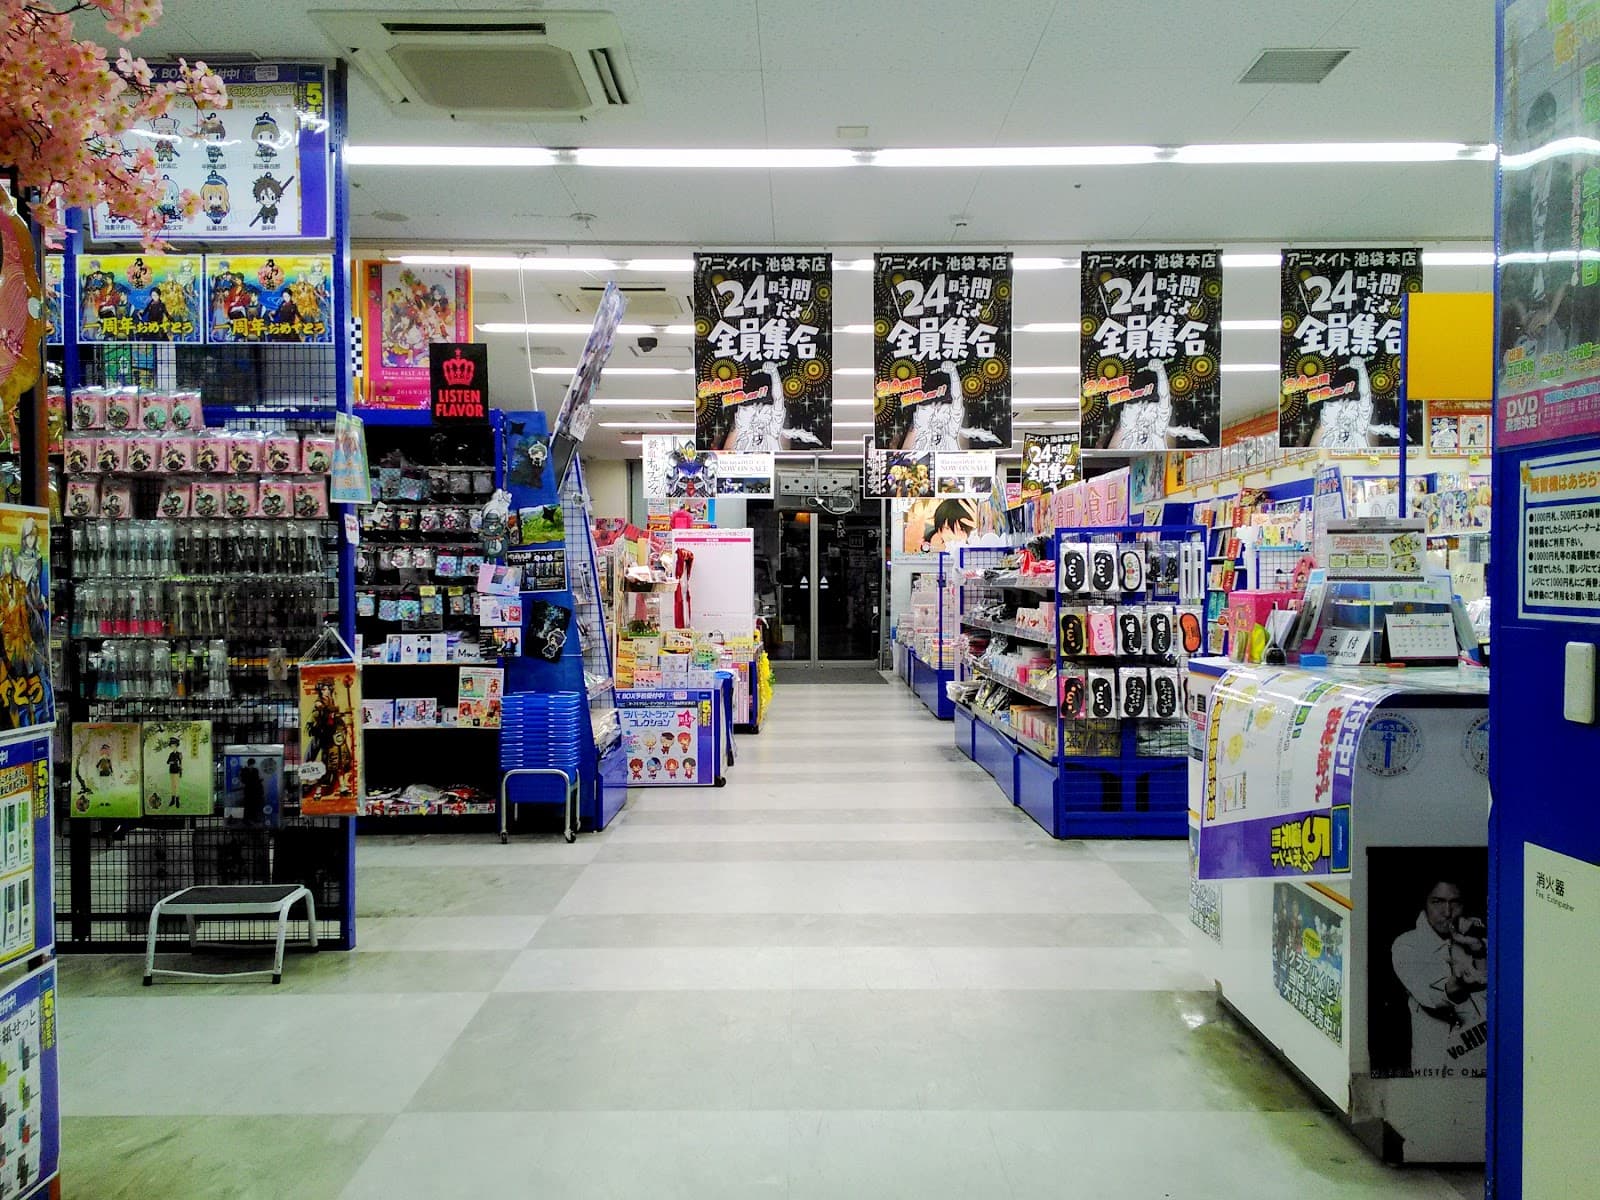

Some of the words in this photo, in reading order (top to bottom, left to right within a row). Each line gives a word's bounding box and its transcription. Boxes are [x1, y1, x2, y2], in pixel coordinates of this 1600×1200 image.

[700, 257, 762, 272] アニメイト
[766, 256, 826, 272] 池袋本店
[880, 257, 942, 271] アニメイト
[946, 256, 1007, 271] 池袋本店
[1087, 254, 1151, 269] アニメイト
[1154, 253, 1217, 269] 池袋本店
[1287, 252, 1351, 267] アニメイト
[1353, 251, 1417, 267] 池袋本店
[718, 274, 812, 318] 24時間
[898, 273, 993, 317] 24時間
[1103, 271, 1201, 315] 24時間
[1303, 269, 1401, 312] 24時間
[707, 317, 820, 362] 全員集合
[887, 317, 998, 362] 全員集合
[1094, 313, 1209, 359] 全員集合
[1293, 312, 1401, 357] 全員集合
[438, 389, 481, 403] LISTEN
[1506, 395, 1539, 418] DVD
[435, 403, 484, 417] FLAVOR
[1030, 443, 1072, 463] 24時間
[1026, 462, 1076, 483] 全員集合
[1530, 472, 1600, 494] 両替機はあちら
[623, 710, 675, 719] ラバーストラップ
[629, 719, 670, 727] コレクション
[1535, 871, 1565, 897] 消火器
